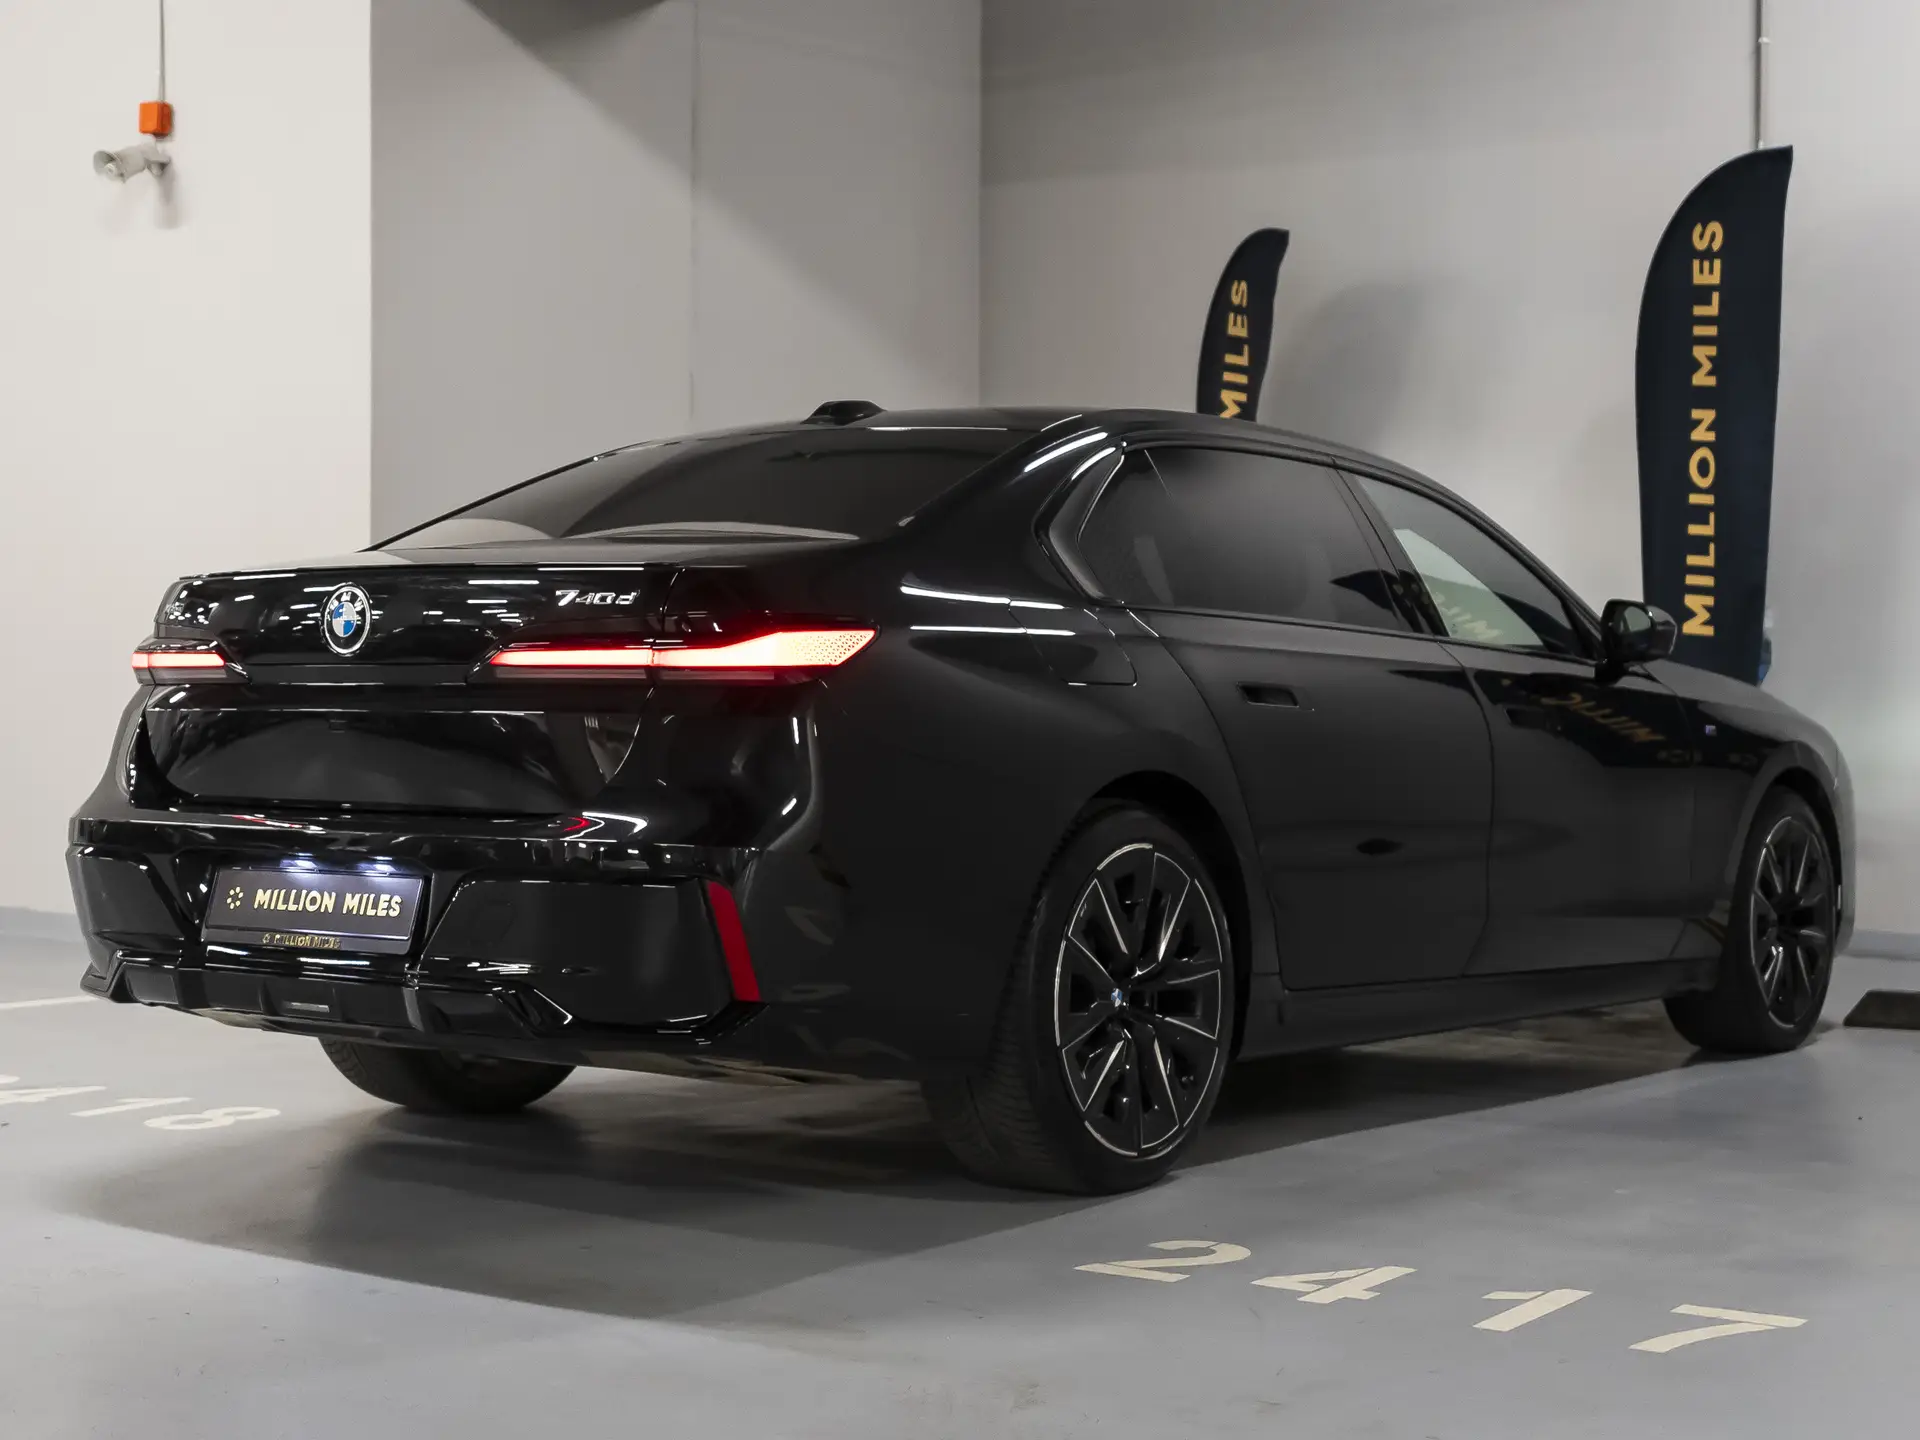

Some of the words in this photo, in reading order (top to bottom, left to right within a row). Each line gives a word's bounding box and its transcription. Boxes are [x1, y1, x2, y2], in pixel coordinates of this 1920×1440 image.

[1219, 279, 1249, 419] MILES
[1692, 219, 1724, 387] MILES
[1682, 408, 1717, 637] MILLION
[330, 591, 364, 611] BMW
[253, 888, 337, 914] MILLION
[342, 893, 402, 918] MILES
